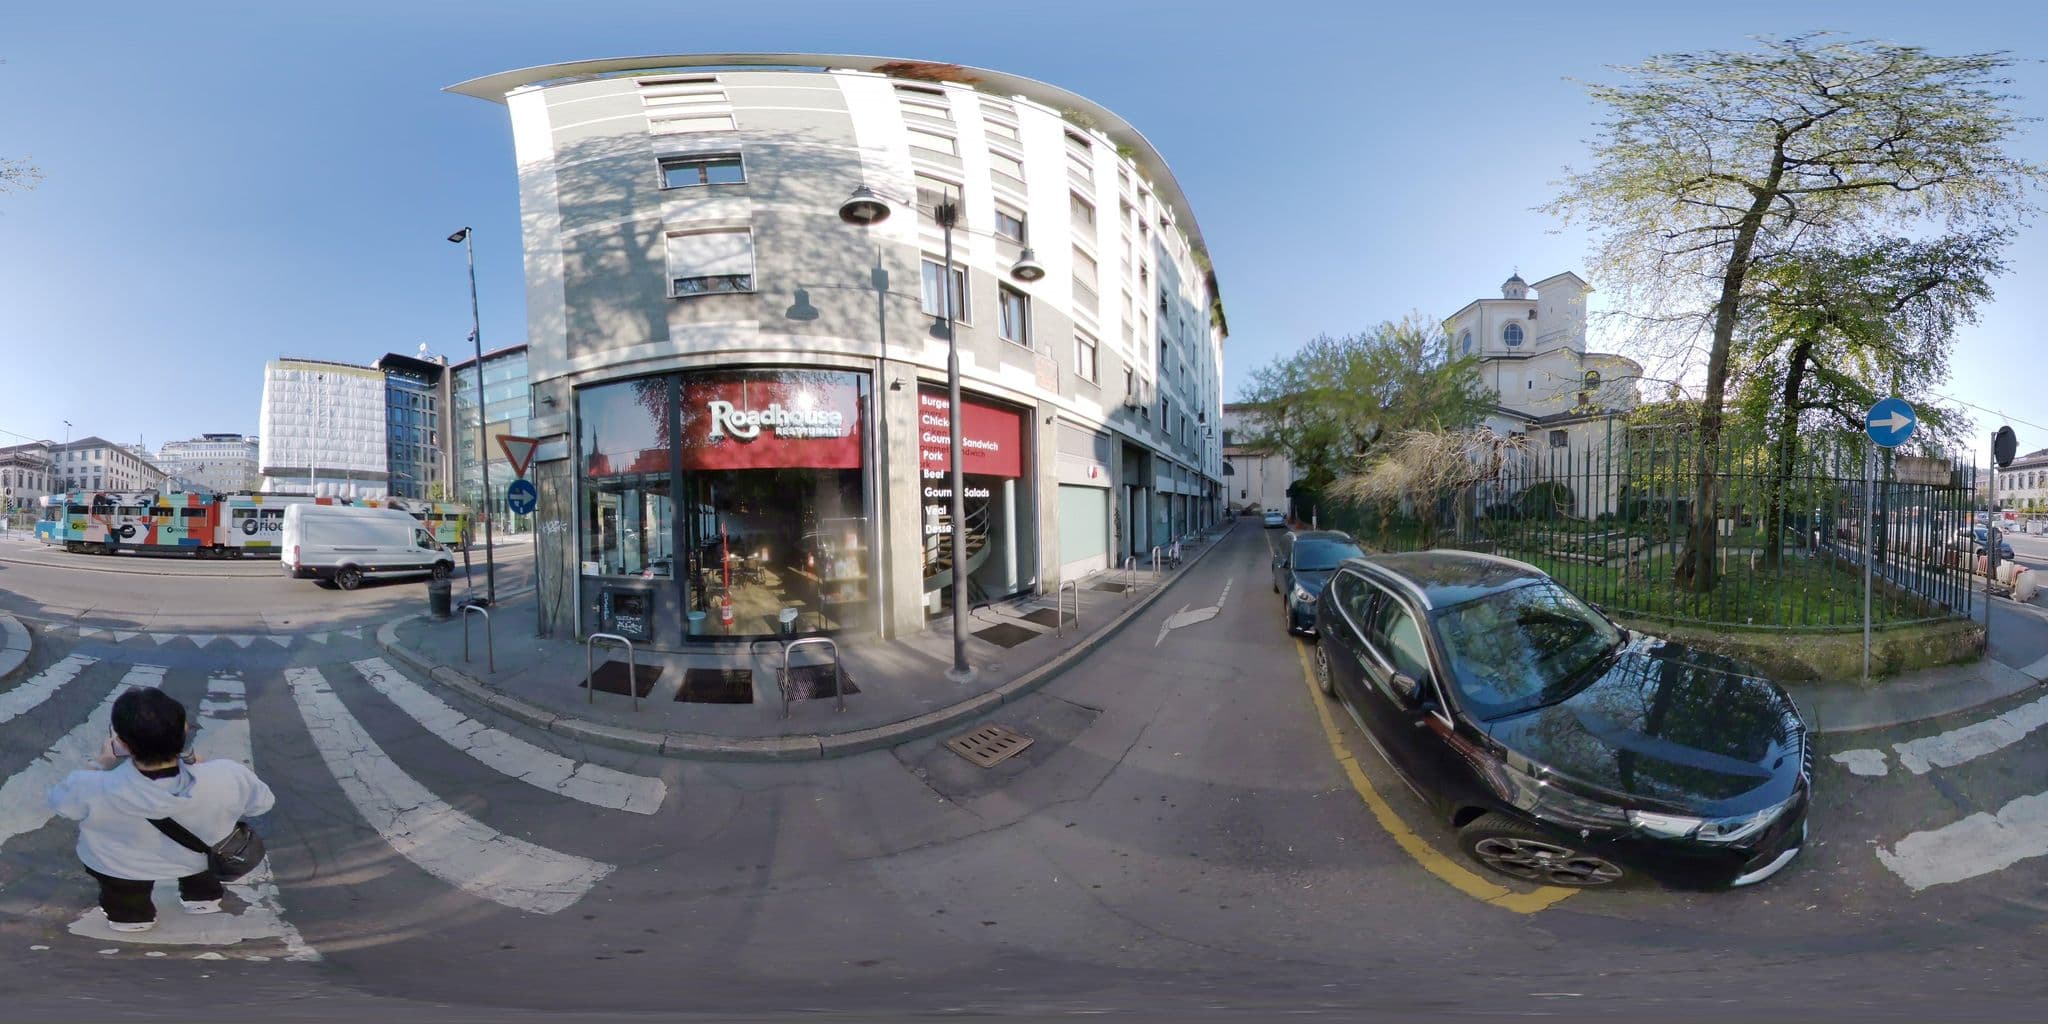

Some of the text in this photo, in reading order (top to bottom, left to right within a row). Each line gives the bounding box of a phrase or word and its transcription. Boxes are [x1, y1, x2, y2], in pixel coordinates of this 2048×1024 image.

[708, 401, 842, 438] Roadhouse
[922, 415, 950, 427] Chick
[963, 437, 998, 451] Sandwich
[923, 450, 943, 461] Pork
[924, 469, 944, 479] Beef
[964, 487, 990, 497] Salads
[925, 505, 947, 515] Veal
[926, 524, 952, 534] Desse
